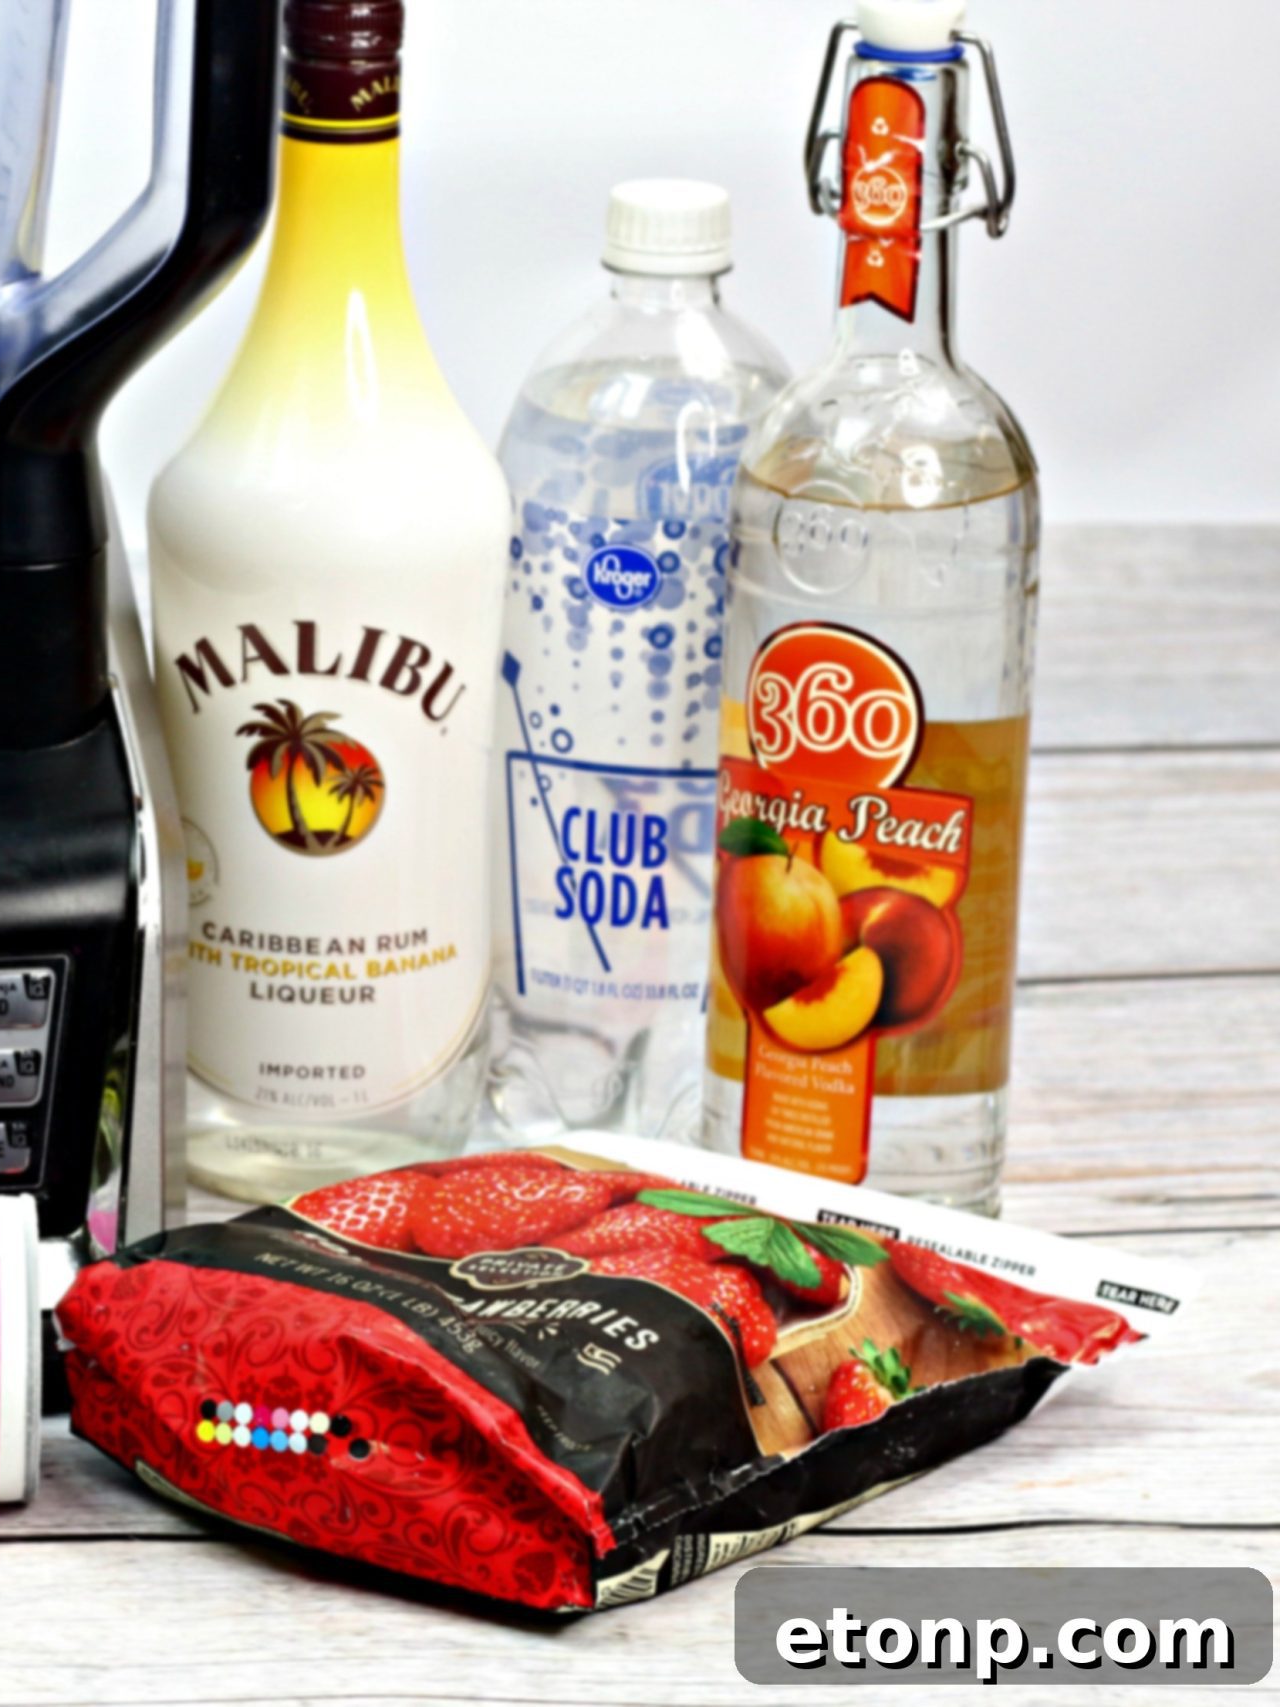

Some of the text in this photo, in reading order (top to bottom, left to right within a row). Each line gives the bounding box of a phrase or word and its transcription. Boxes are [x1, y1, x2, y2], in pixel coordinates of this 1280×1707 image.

[593, 554, 652, 600] Kroger
[174, 620, 466, 722] MALIBU
[756, 662, 912, 763] 360
[561, 806, 669, 869] CLUB
[838, 794, 966, 855] Peach
[554, 864, 670, 930] SODA
[188, 940, 458, 981] ITH TROPICAL BANANA
[201, 920, 428, 956] CARIBBEAN RUM
[249, 981, 376, 1005] LIQUEUR
[259, 1062, 366, 1080] IMPORTED
[991, 1256, 1037, 1277] ZIPPER
[295, 1260, 326, 1277] WT
[327, 1271, 353, 1287] 16
[437, 1309, 483, 1354] 453g
[1102, 1284, 1176, 1313] TEAR HERE
